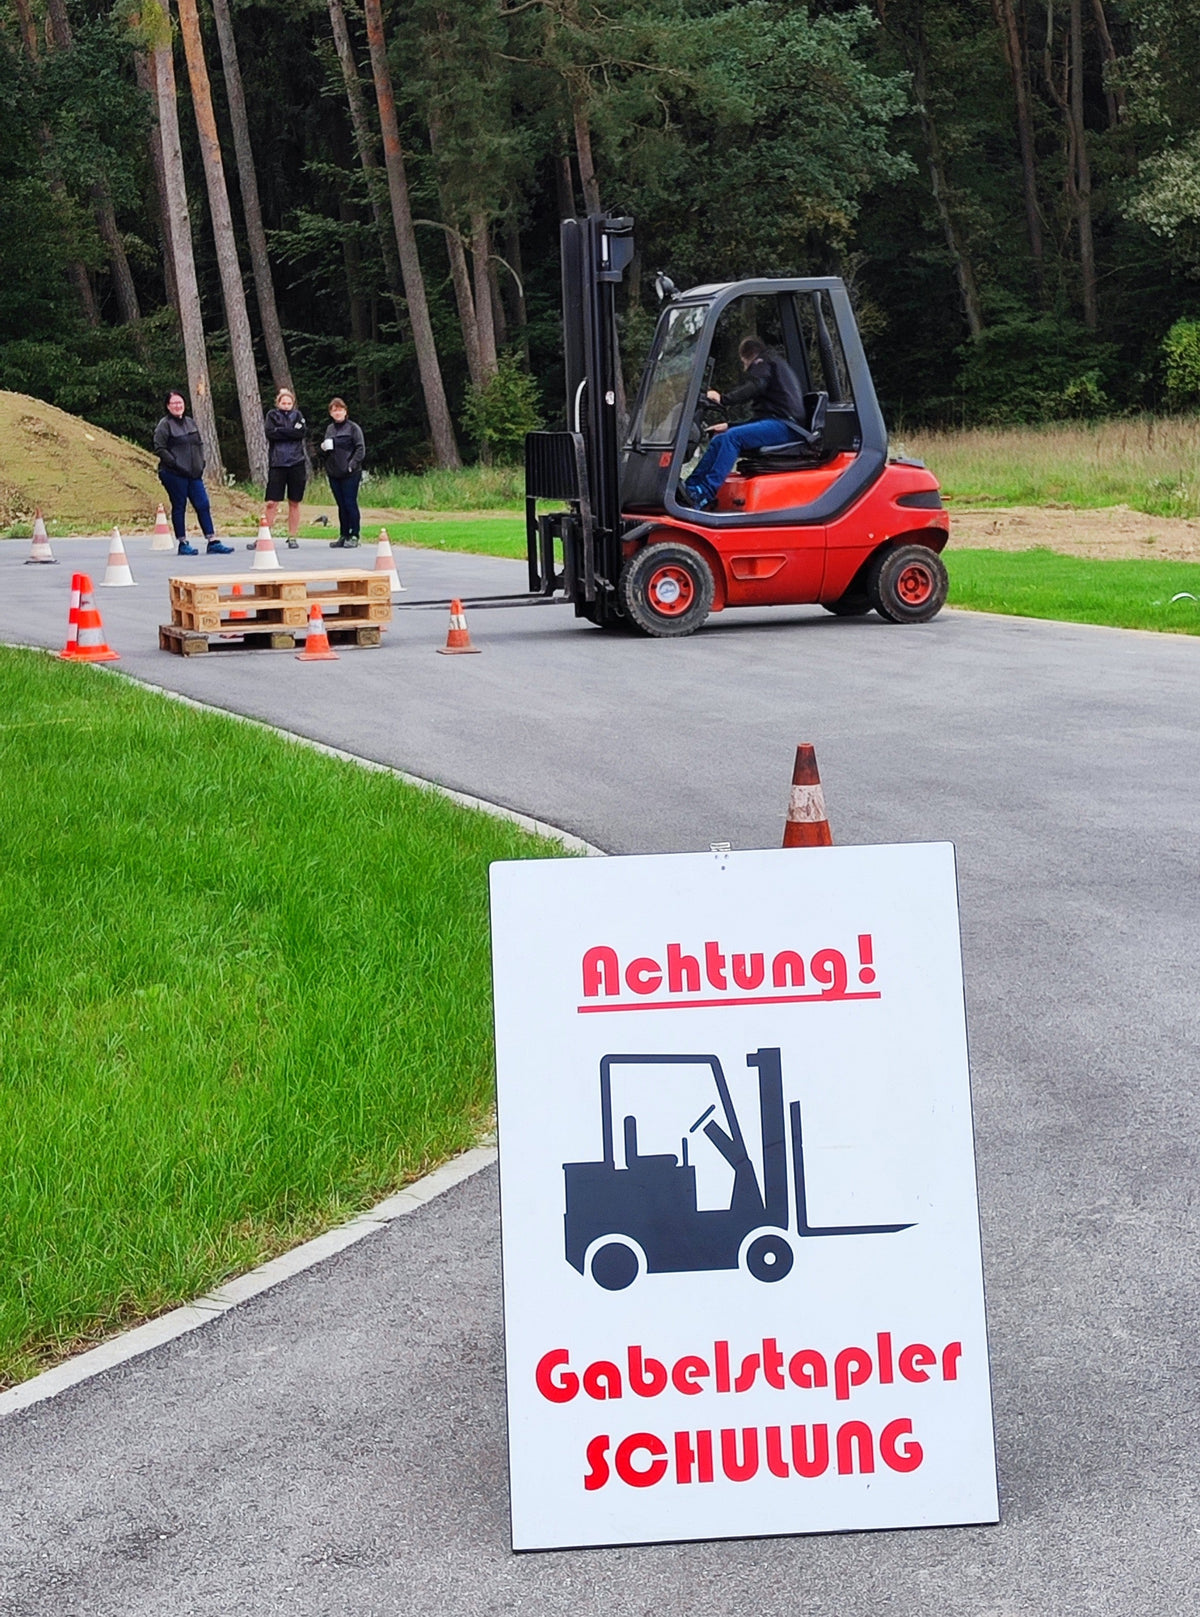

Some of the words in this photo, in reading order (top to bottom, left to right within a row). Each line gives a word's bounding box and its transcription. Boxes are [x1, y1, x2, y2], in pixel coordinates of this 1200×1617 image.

[582, 934, 876, 1001] Achtung!
[535, 1332, 962, 1403] Gabelstapler
[584, 1418, 924, 1491] SCHULUNG
